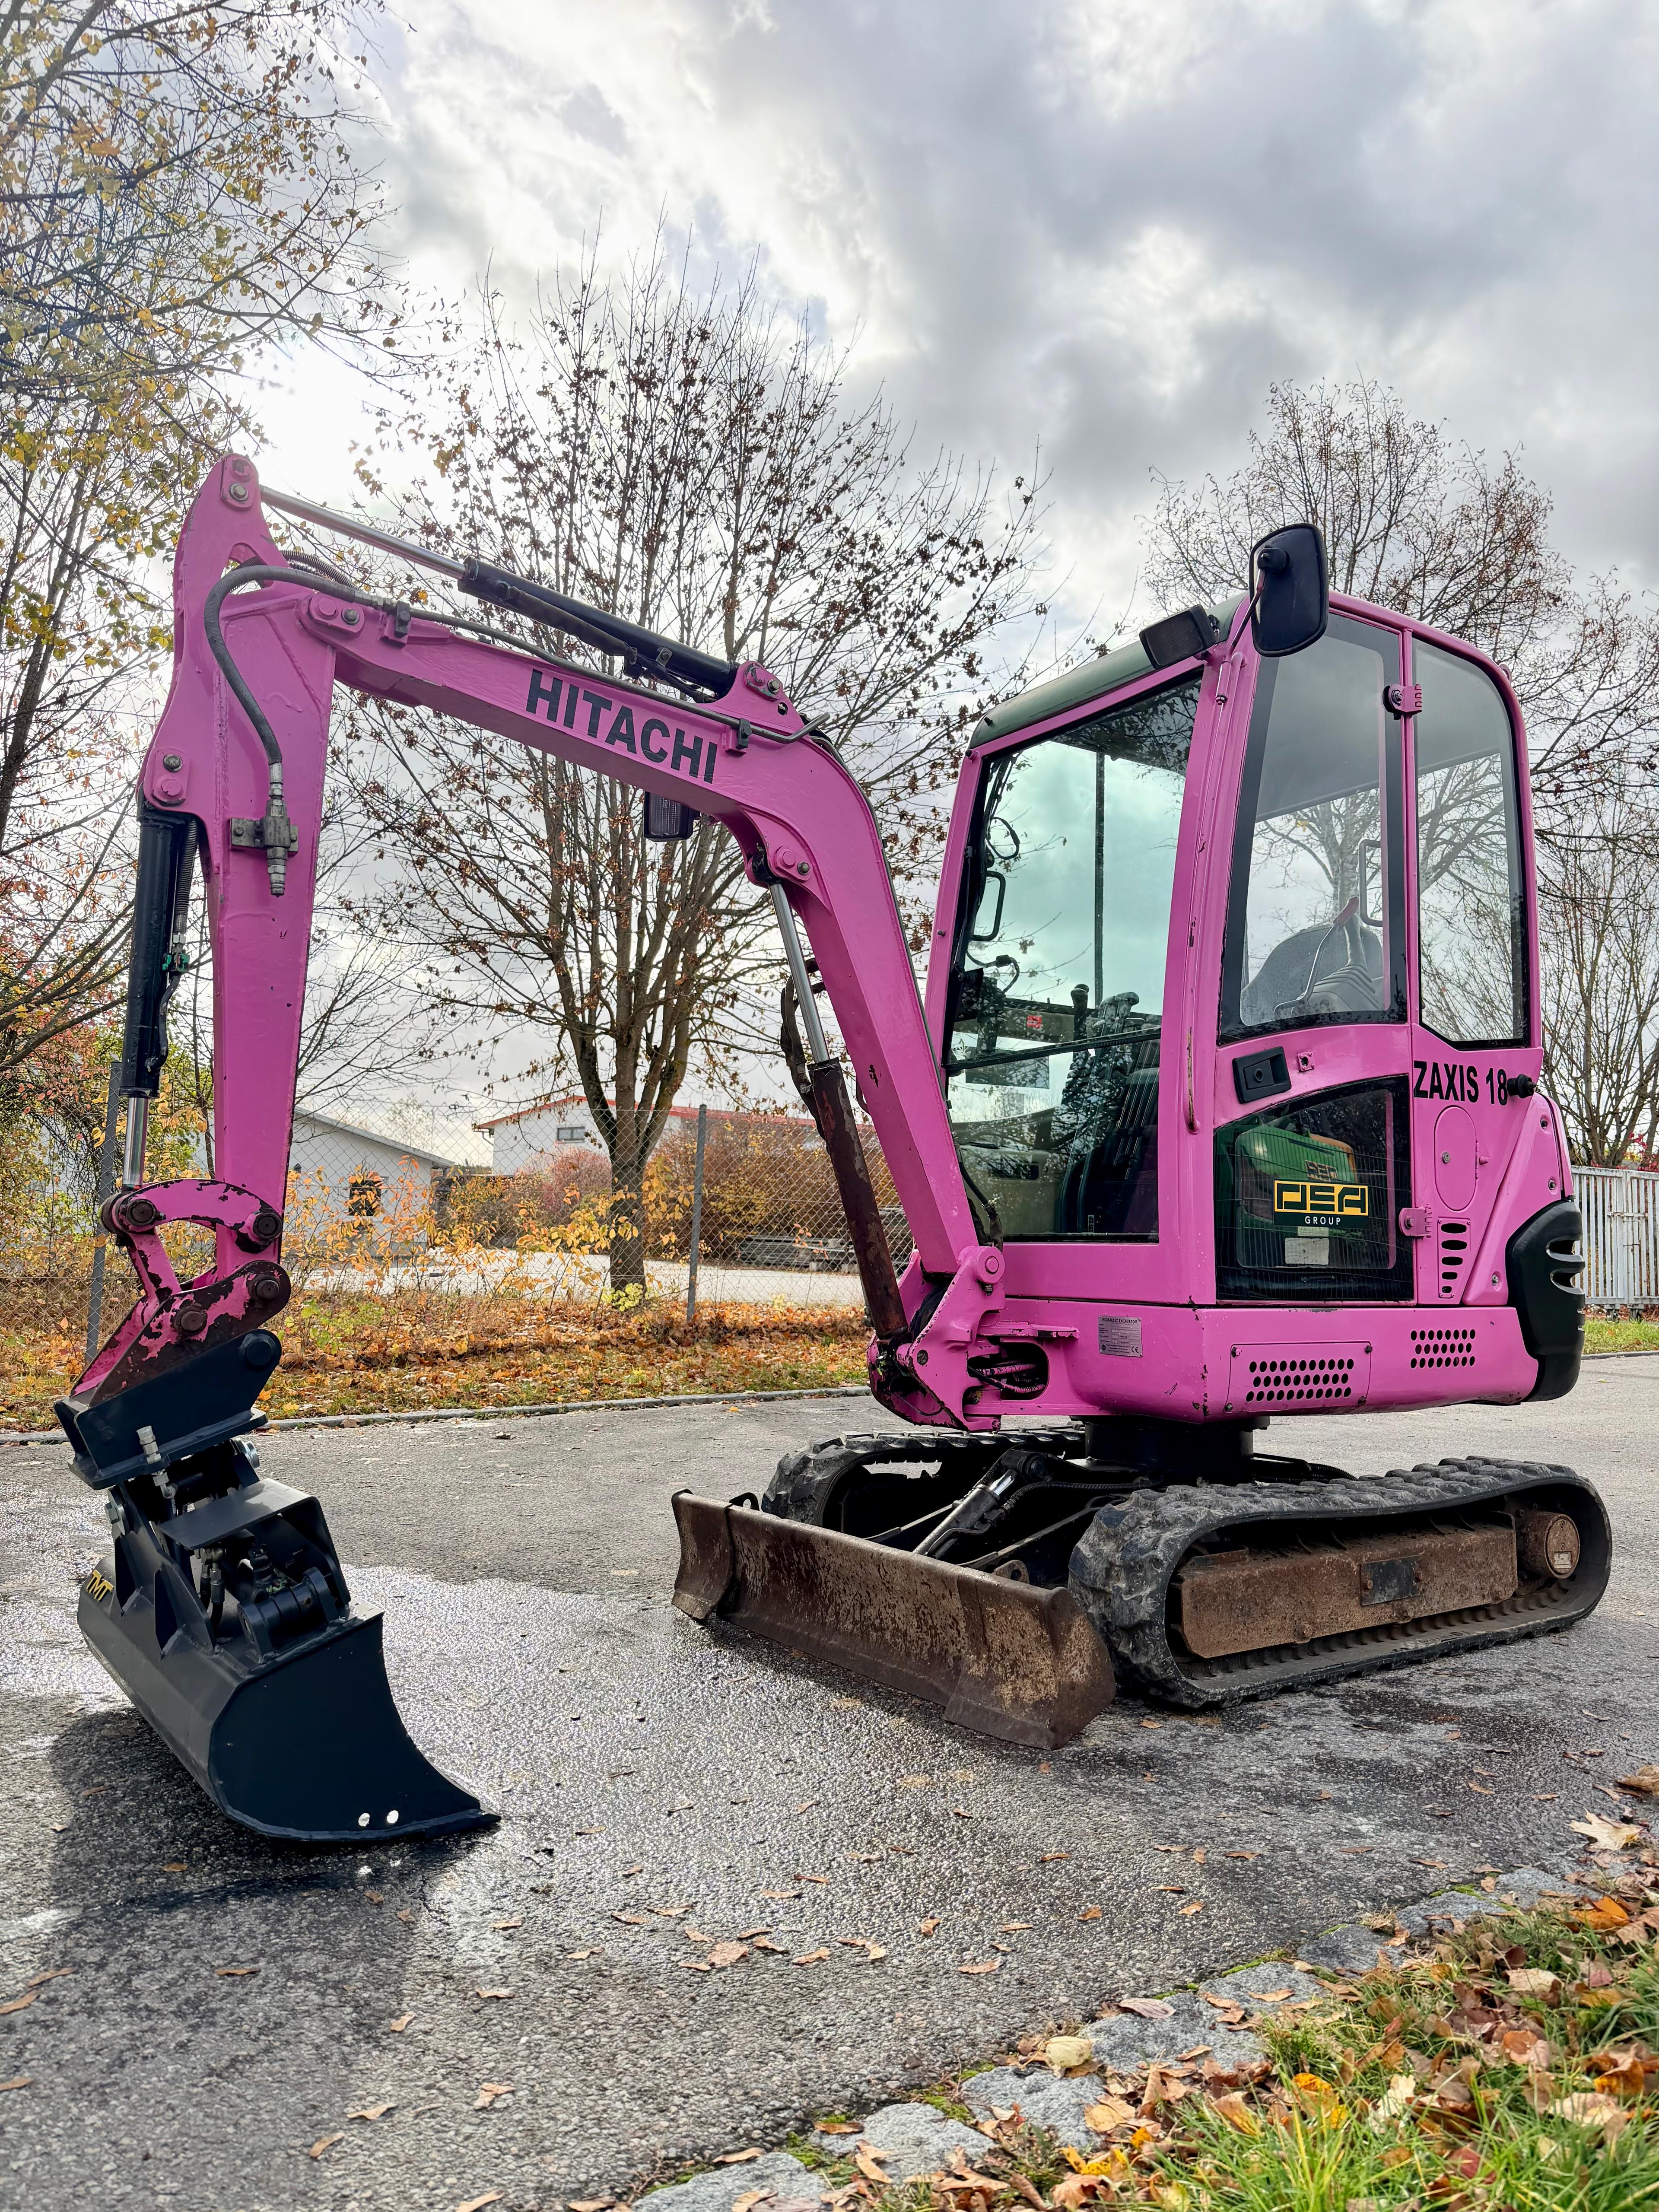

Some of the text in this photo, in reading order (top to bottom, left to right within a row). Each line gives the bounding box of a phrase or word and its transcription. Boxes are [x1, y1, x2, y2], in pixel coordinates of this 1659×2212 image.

[526, 668, 718, 784] HITACHI
[1414, 1060, 1508, 1106] ZAXIS 18
[1305, 1216, 1341, 1225] GROUP
[86, 1569, 114, 1602] TMT
